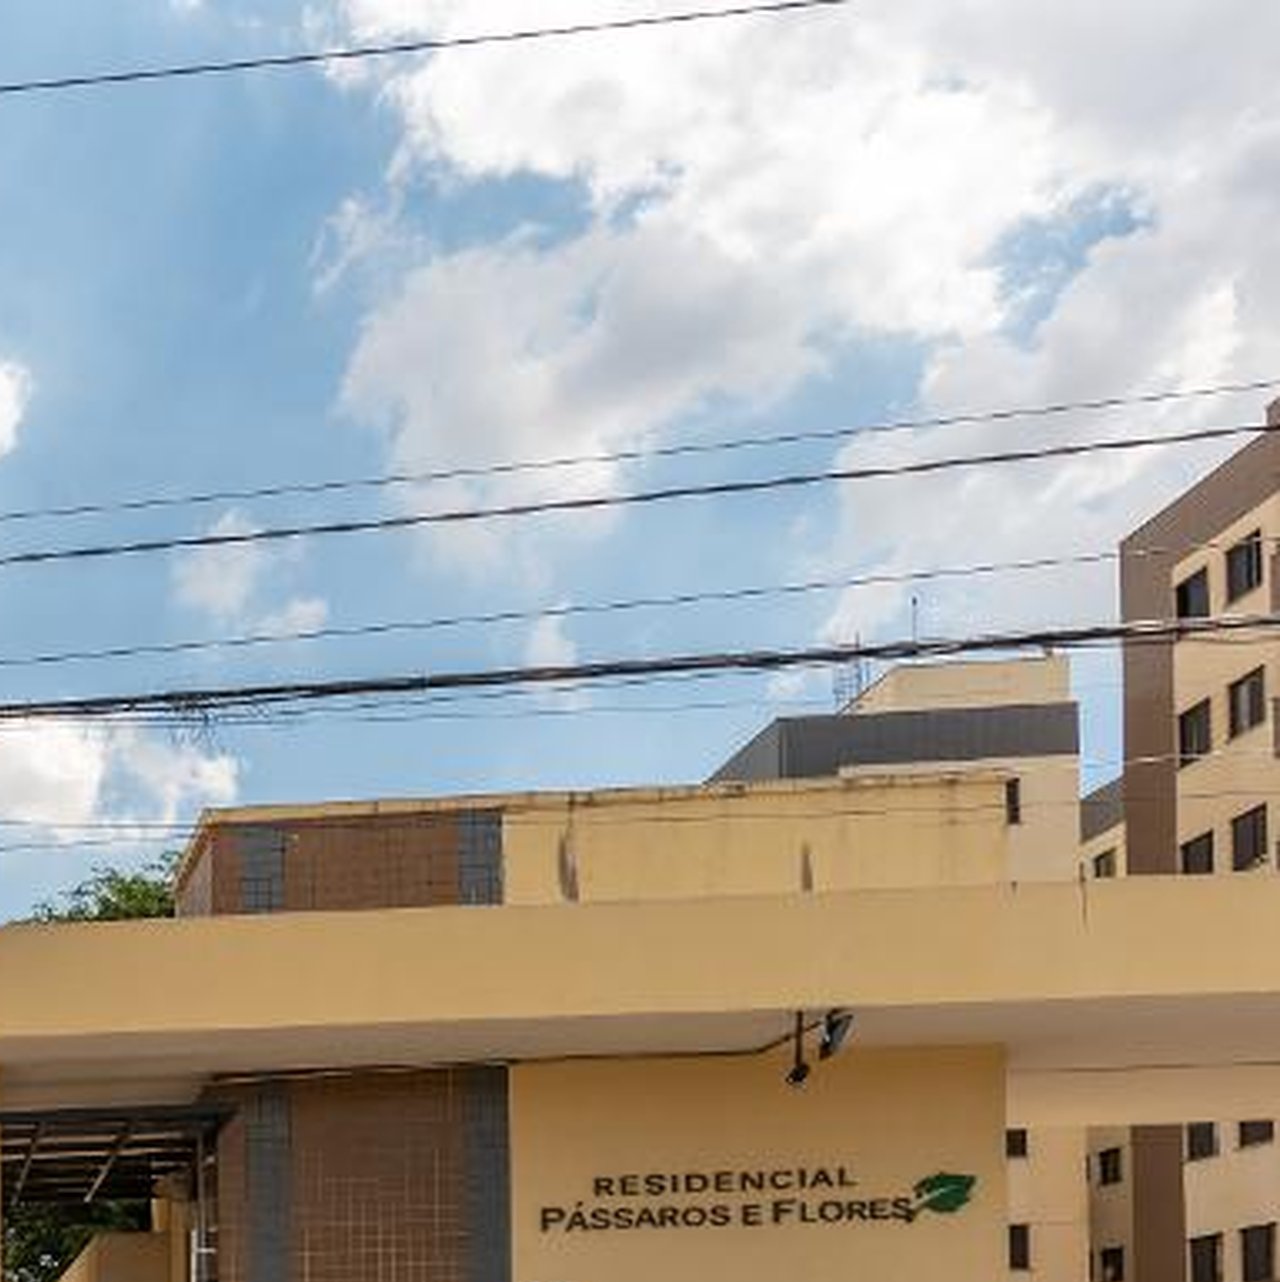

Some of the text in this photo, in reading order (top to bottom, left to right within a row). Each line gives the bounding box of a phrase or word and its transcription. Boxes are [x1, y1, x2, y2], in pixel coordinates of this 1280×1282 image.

[593, 1166, 859, 1197] RESIDENCIAL
[540, 1198, 913, 1233] PÁSSAROS E FLORES
